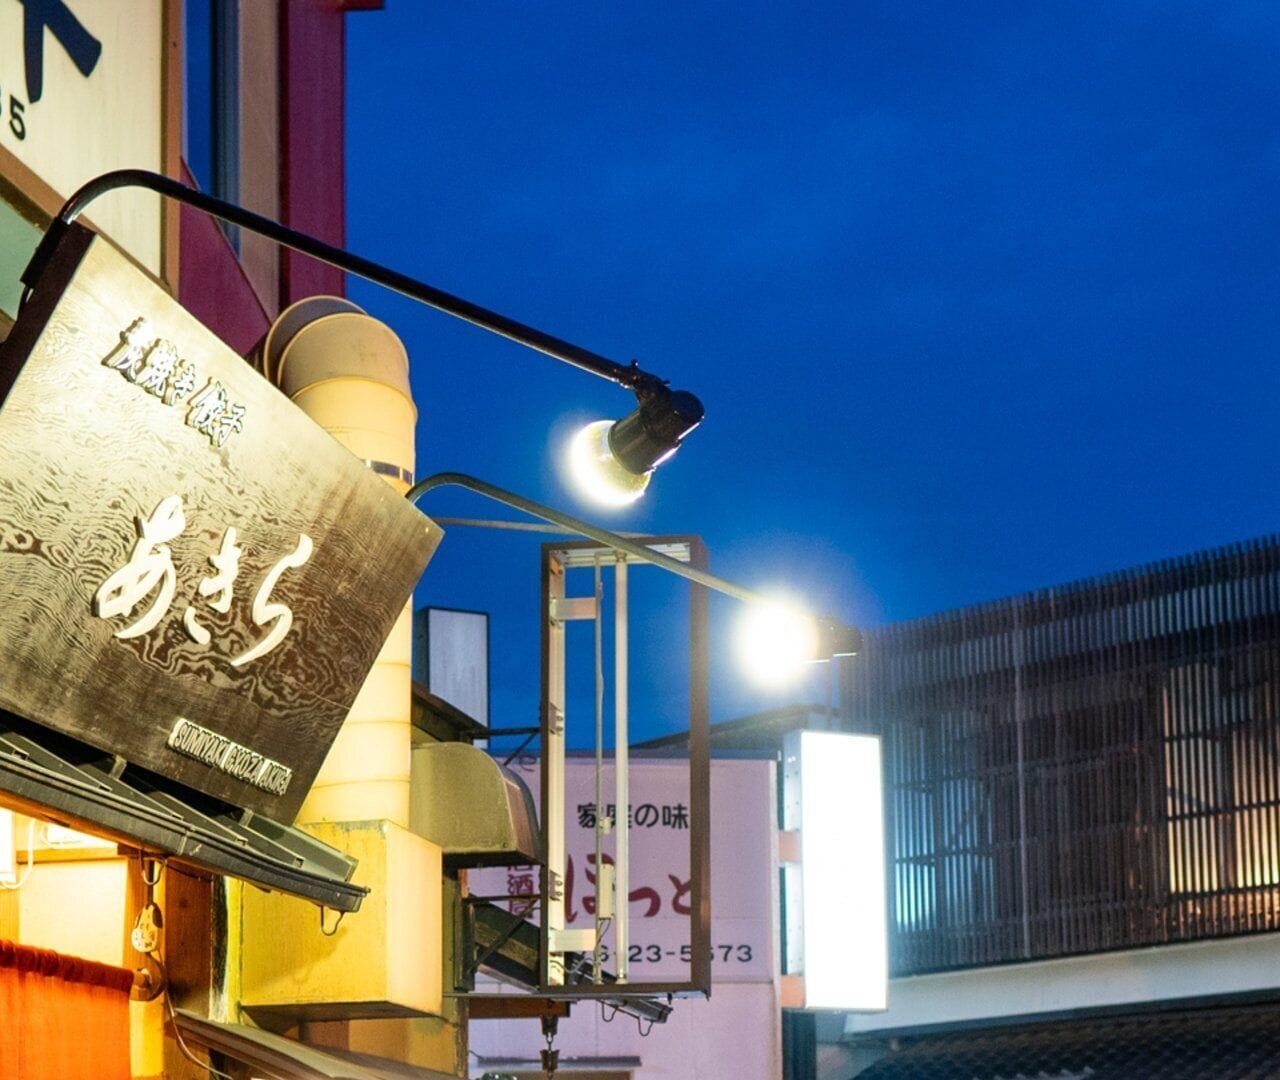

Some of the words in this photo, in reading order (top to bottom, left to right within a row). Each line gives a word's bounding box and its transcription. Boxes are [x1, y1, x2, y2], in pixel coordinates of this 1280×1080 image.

[184, 376, 246, 447] 餃子
[91, 495, 314, 667] あきら
[173, 720, 231, 767] SUMIYAKI
[223, 744, 265, 784] GYOZA
